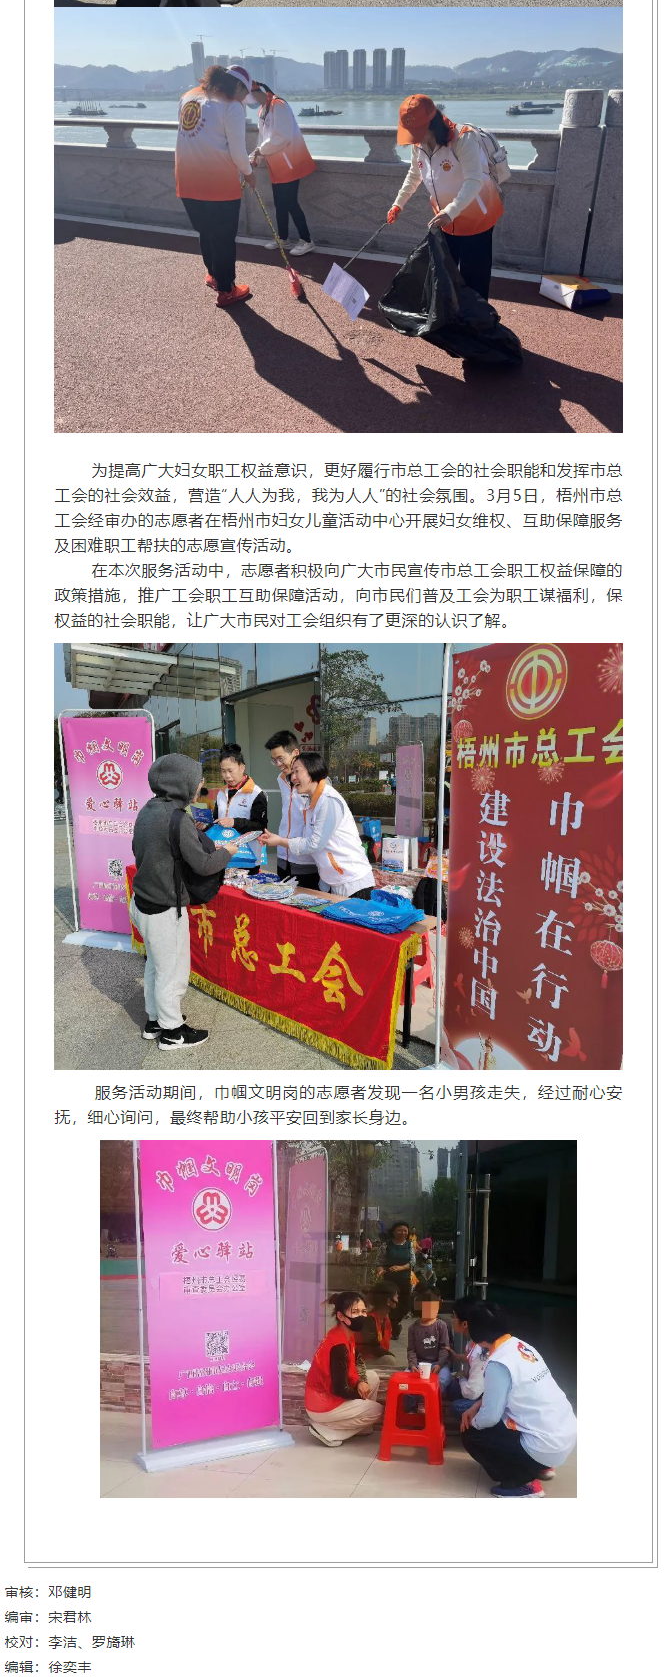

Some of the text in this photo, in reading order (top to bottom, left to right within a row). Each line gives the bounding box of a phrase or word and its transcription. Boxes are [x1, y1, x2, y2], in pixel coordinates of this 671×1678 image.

[91, 462, 623, 478] 为提高广大妇女职工权益意识，更好履行市总工会的社会职能和发挥市总
[54, 512, 623, 528] 工会经审办的志愿者在梧州市妇女儿童活动中心开展妇女维权、互助保障服务
[54, 537, 292, 553] 及困难职工帮扶的志愿宣传活动。
[91, 562, 623, 578] 在本次服务活动中，志愿者积极向广大市民宣传市总工会职工权益保障的
[54, 587, 623, 603] 政策措施，推广工会职工互助保障活动，向市民们普及工会为职工谋福利，保
[54, 612, 508, 628] 权益的社会职能，让广大市民对工会组织有了更深的认识了解。
[456, 719, 623, 769] 梧州市总工会
[85, 797, 139, 812] 爱心驿站
[470, 789, 511, 1021] 建设法治中国
[526, 791, 584, 1063] 巾帼在行动
[189, 903, 364, 1012] 市总工会
[94, 1084, 623, 1100] 服务活动期间，巾帼文明岗的志愿者发现一名小男孩走失，经过耐心安
[54, 1109, 409, 1125] 抚，细心询问，最终帮助小孩平安回到家长身边。
[155, 1154, 264, 1198] 巾帼文明岗
[170, 1241, 256, 1265] 爱心驿站
[4, 1586, 91, 1599] 审核：邓健明
[4, 1611, 92, 1624] 编审：宋君林
[4, 1635, 136, 1650] 校对：李洁、罗旖琳
[4, 1661, 92, 1674] 编辑：徐奕丰
